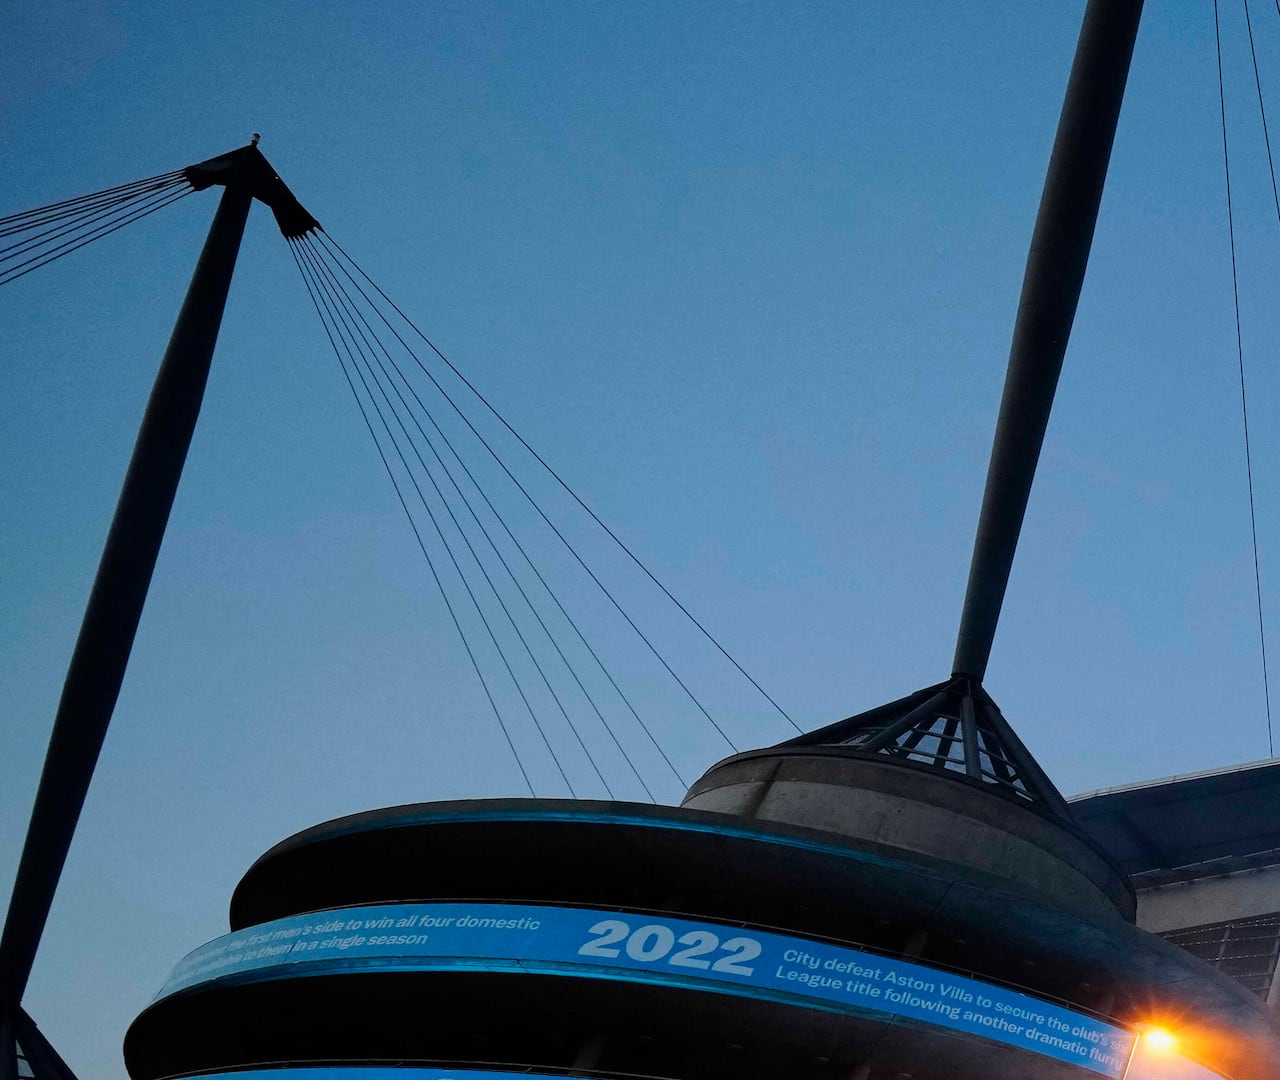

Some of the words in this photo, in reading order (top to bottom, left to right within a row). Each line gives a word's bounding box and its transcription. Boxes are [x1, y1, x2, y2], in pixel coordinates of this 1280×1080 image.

[420, 914, 454, 927] four
[456, 914, 540, 931] domestic
[578, 920, 762, 976] 2022
[775, 964, 842, 990] League
[846, 980, 881, 999] title
[884, 988, 960, 1020] following
[962, 1010, 1024, 1036] another
[1025, 1026, 1088, 1057] dramatic
[783, 949, 820, 970] City
[824, 957, 880, 981] defeat
[885, 971, 935, 993] Aston
[940, 983, 973, 1003] Villa
[976, 992, 992, 1008] to
[994, 1001, 1045, 1024] secure
[1047, 1015, 1070, 1034] the
